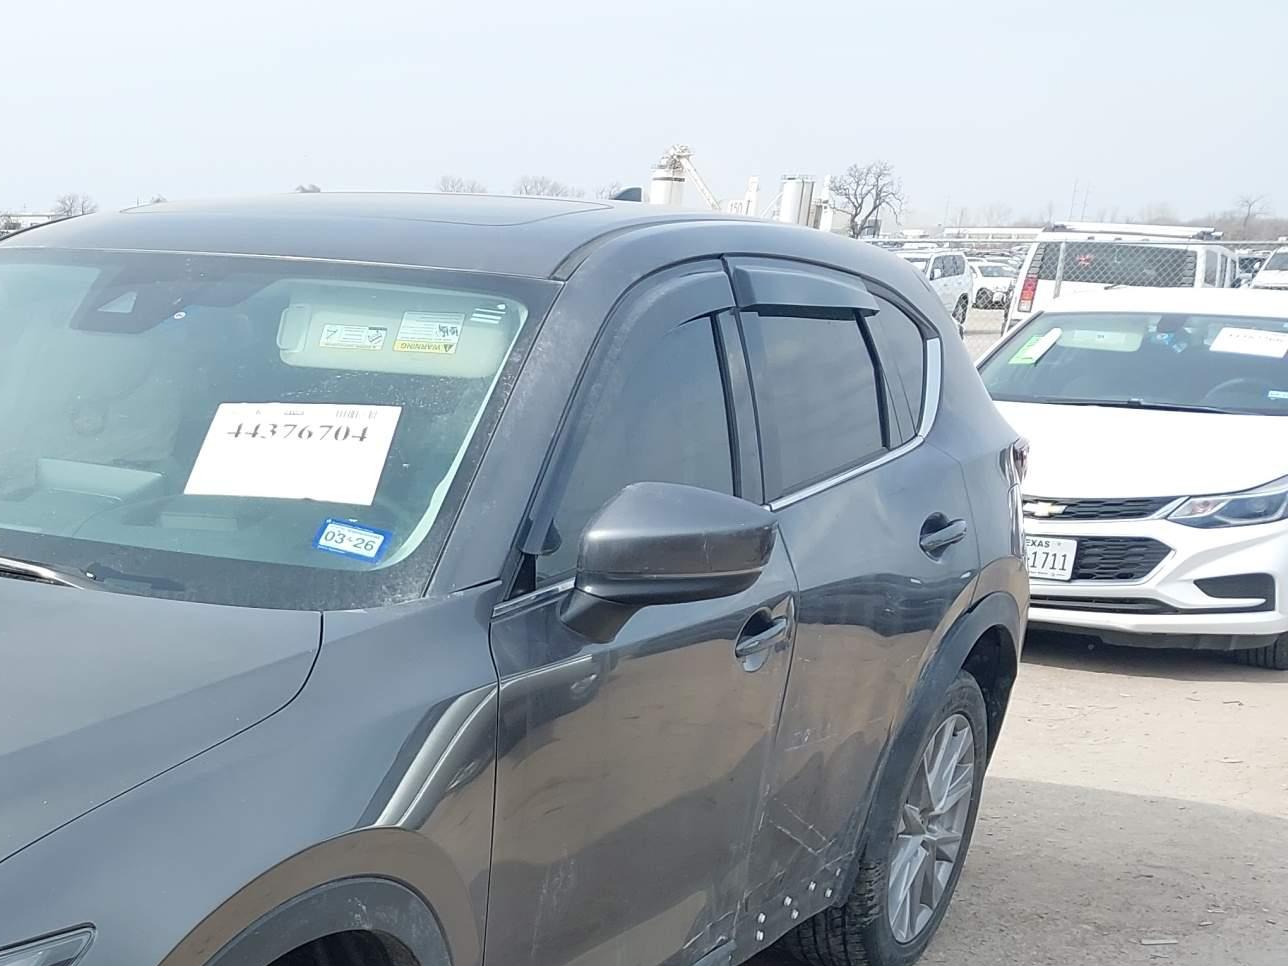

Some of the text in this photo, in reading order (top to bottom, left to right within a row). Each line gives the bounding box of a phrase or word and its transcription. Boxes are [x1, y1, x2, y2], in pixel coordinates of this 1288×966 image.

[226, 423, 369, 442] 44376704
[324, 530, 346, 544] 03
[352, 537, 377, 551] 26
[1025, 538, 1051, 548] EXAS
